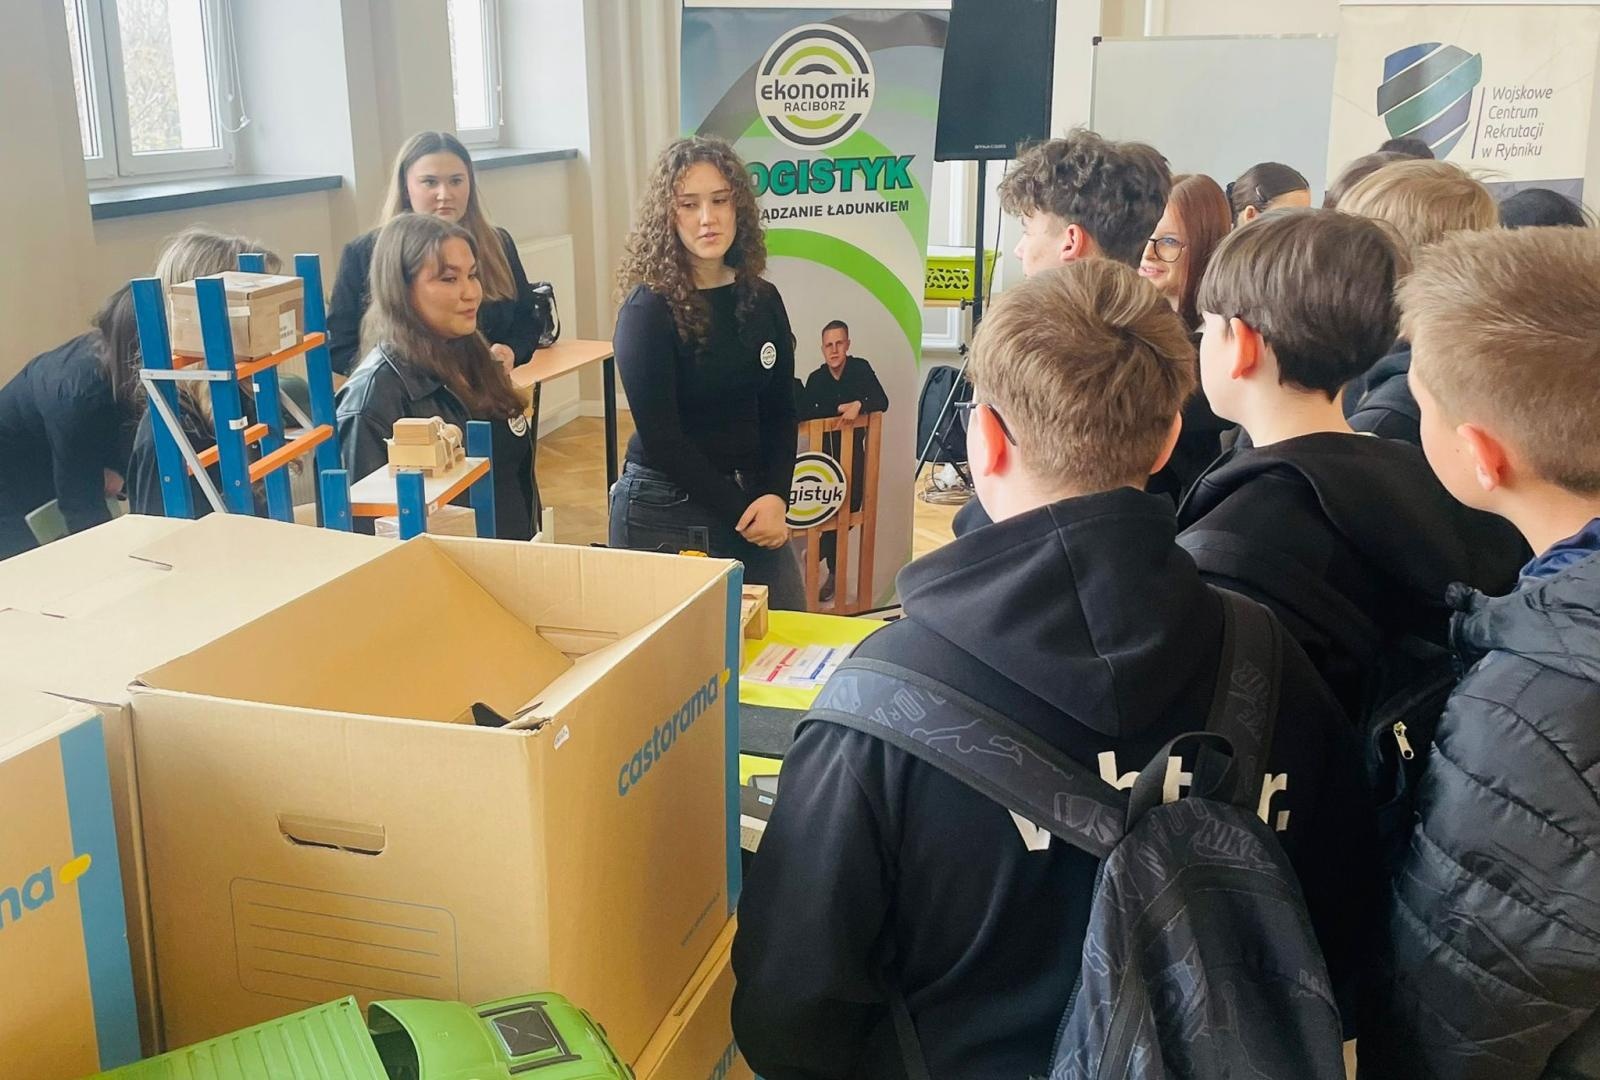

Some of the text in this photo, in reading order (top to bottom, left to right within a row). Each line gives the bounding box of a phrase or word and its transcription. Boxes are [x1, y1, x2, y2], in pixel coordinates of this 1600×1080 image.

[761, 77, 869, 101] ekonomik
[1492, 85, 1553, 103] Wojskowe
[784, 99, 846, 112] RACIBÓRZ
[1488, 105, 1538, 120] Centrum
[1484, 122, 1545, 140] Rekrutacji
[1481, 143, 1543, 161] w Rybniku
[826, 200, 909, 216] ŁADUNKIEM
[789, 486, 843, 505] gistyk
[618, 673, 719, 797] castorama
